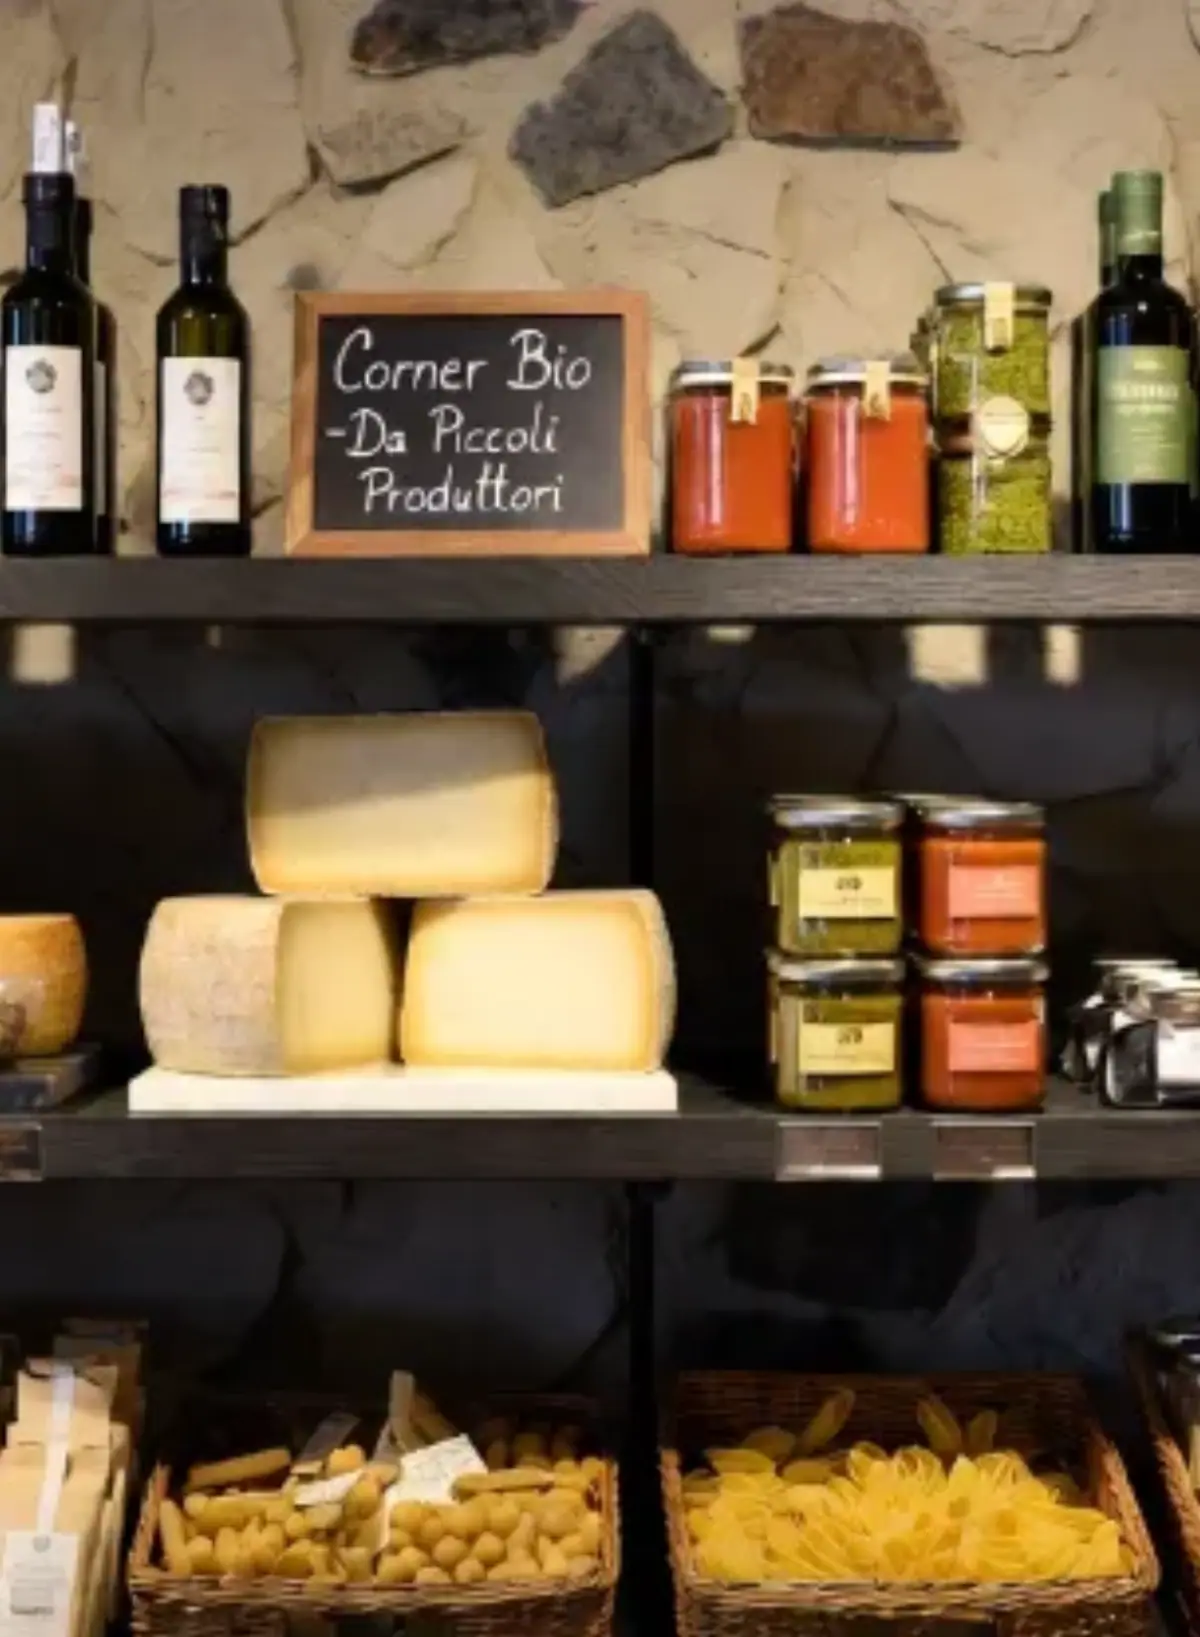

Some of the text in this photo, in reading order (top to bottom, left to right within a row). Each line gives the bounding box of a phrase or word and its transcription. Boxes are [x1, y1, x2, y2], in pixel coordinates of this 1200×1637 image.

[334, 326, 592, 393] Corner Bio
[428, 400, 561, 453] Piccoli
[358, 460, 564, 513] Produttori
